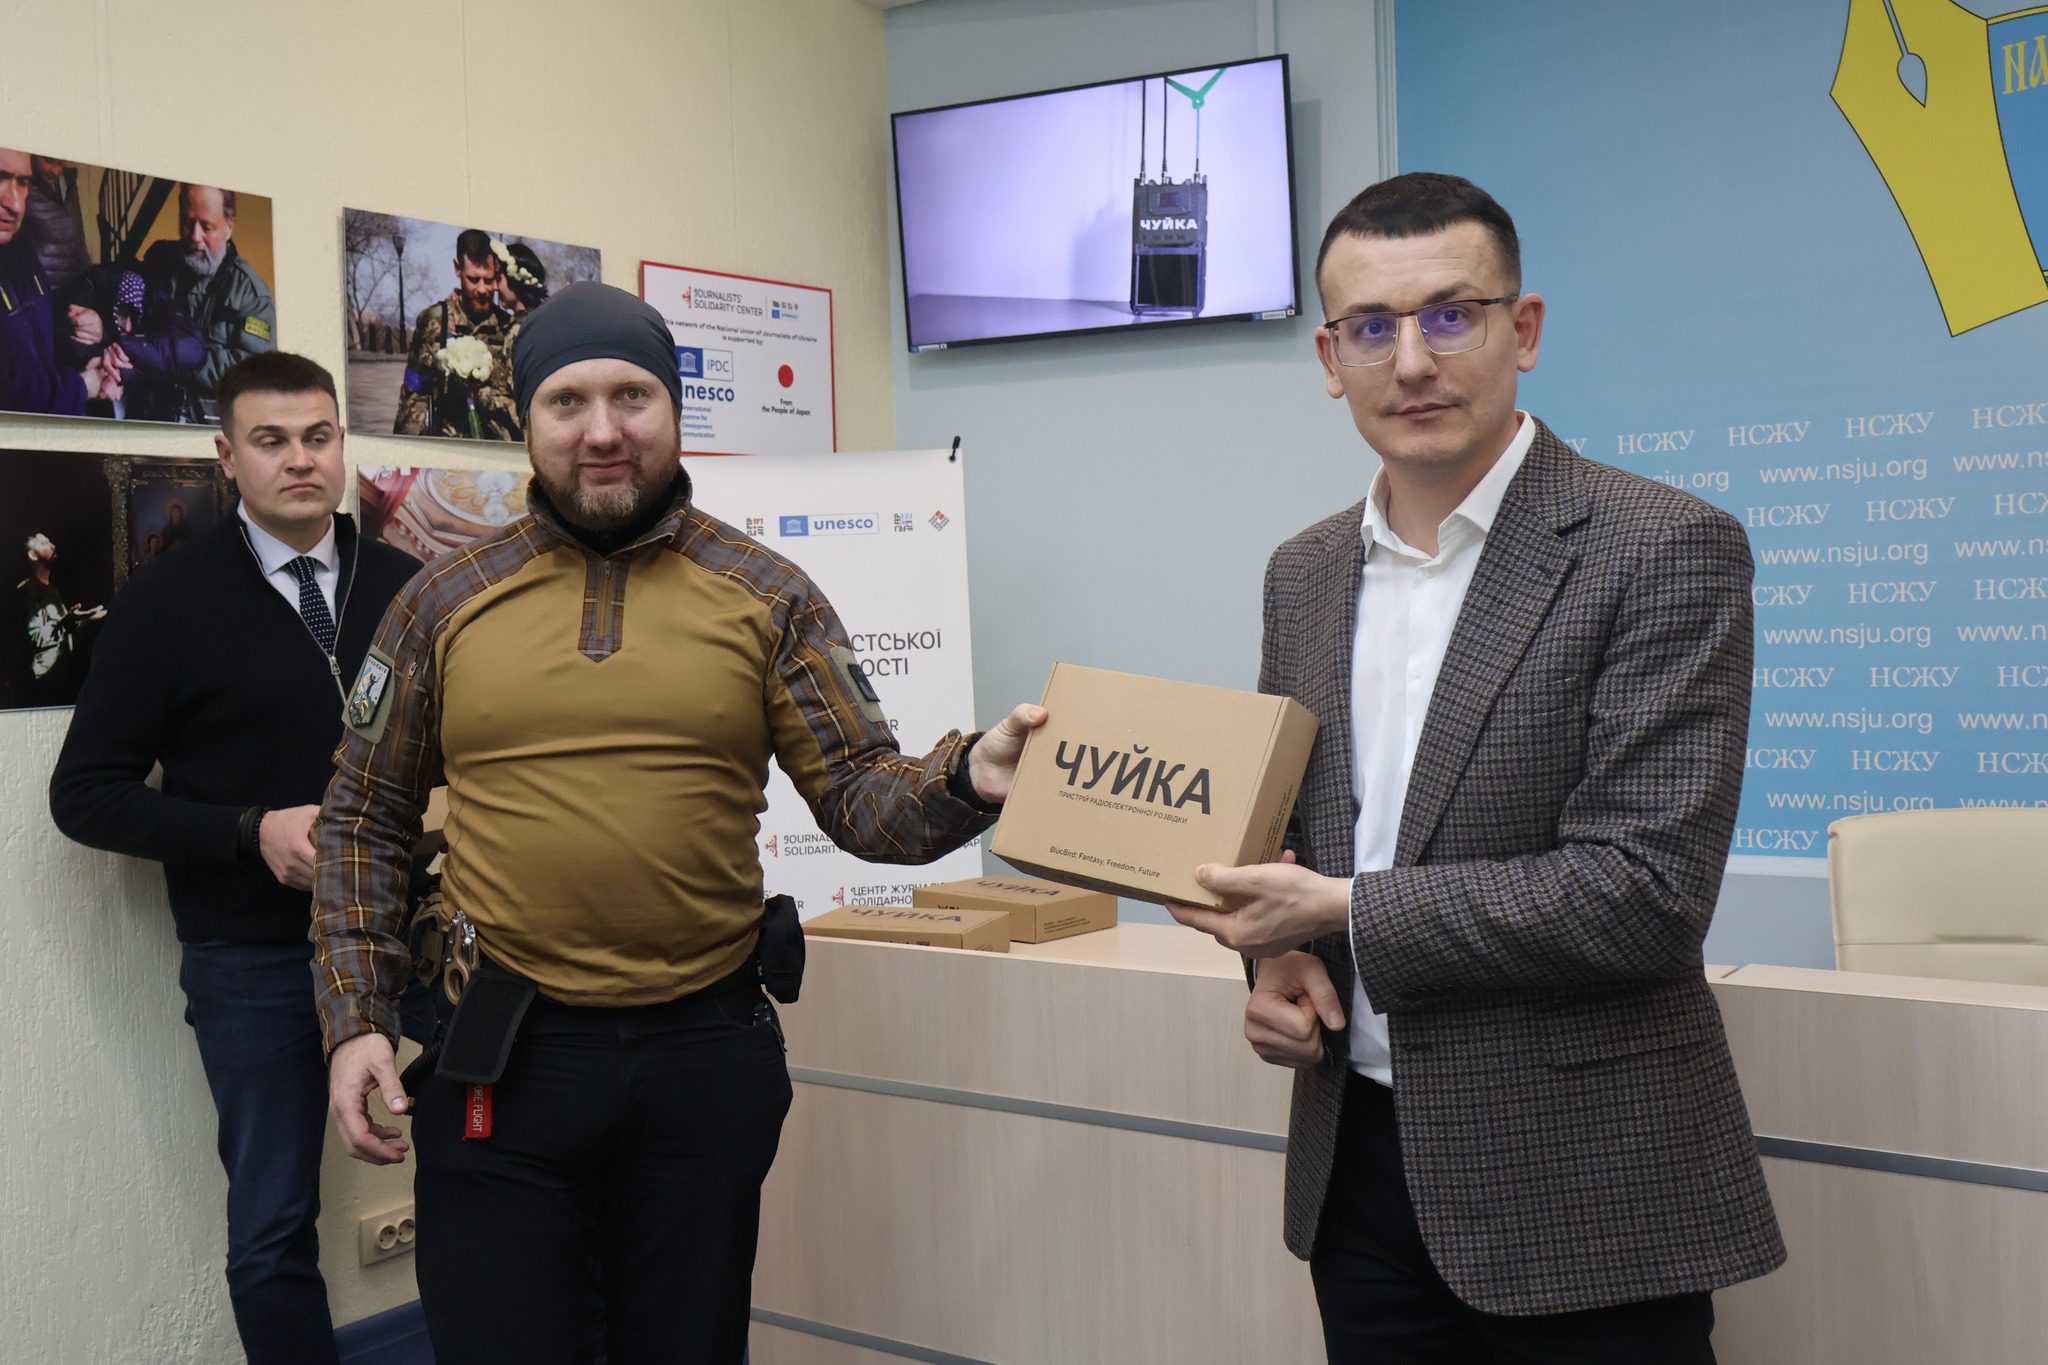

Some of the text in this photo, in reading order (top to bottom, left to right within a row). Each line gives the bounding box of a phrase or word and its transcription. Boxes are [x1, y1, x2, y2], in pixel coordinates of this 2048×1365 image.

[1140, 217, 1198, 230] ЧУЙКА
[694, 300, 764, 316] SOLIDARITY CENTER
[707, 360, 730, 373] IPDC
[685, 384, 735, 402] nesco
[780, 398, 792, 406] From
[762, 405, 770, 413] the
[771, 405, 788, 414] People
[1617, 430, 1695, 455] НСЖУ
[1727, 420, 1812, 447] НСЖУ
[1845, 411, 1935, 438] НСЖУ
[1972, 402, 2048, 429] НСЖ
[1760, 457, 1928, 485] www.nsju.org
[1952, 451, 2048, 472] www.n
[1746, 492, 2048, 528] НСЖУ НСЖУ НС
[814, 517, 874, 531] unesco
[1761, 538, 2048, 566] www.nsju.org www.n
[1752, 577, 2048, 606] СЖУ НСЖУ НСЖ
[851, 628, 942, 653] СТСЬКОЇ
[1763, 623, 2048, 648] www.nsju.org www.n
[860, 657, 909, 677] ОСТІ
[1752, 665, 2048, 688] НСЖУ НСЖУ НС
[1765, 707, 2048, 734] www.nsju.org www.n
[1851, 750, 1941, 772] НСЖУ
[1977, 751, 2048, 774] НСЖ
[1055, 740, 1212, 815] ЧУЙКА
[1059, 790, 1089, 803] ПРИСТРІЙ
[1154, 812, 1187, 824] РОЗВІДКИ
[783, 834, 832, 845] JOURNAL
[1735, 828, 1819, 850] НСЖУ
[784, 845, 842, 856] SOLIDARIT
[1138, 866, 1161, 878] Future
[851, 893, 912, 907] СОЛІДАРНО
[472, 1104, 484, 1132] FLIGHT
